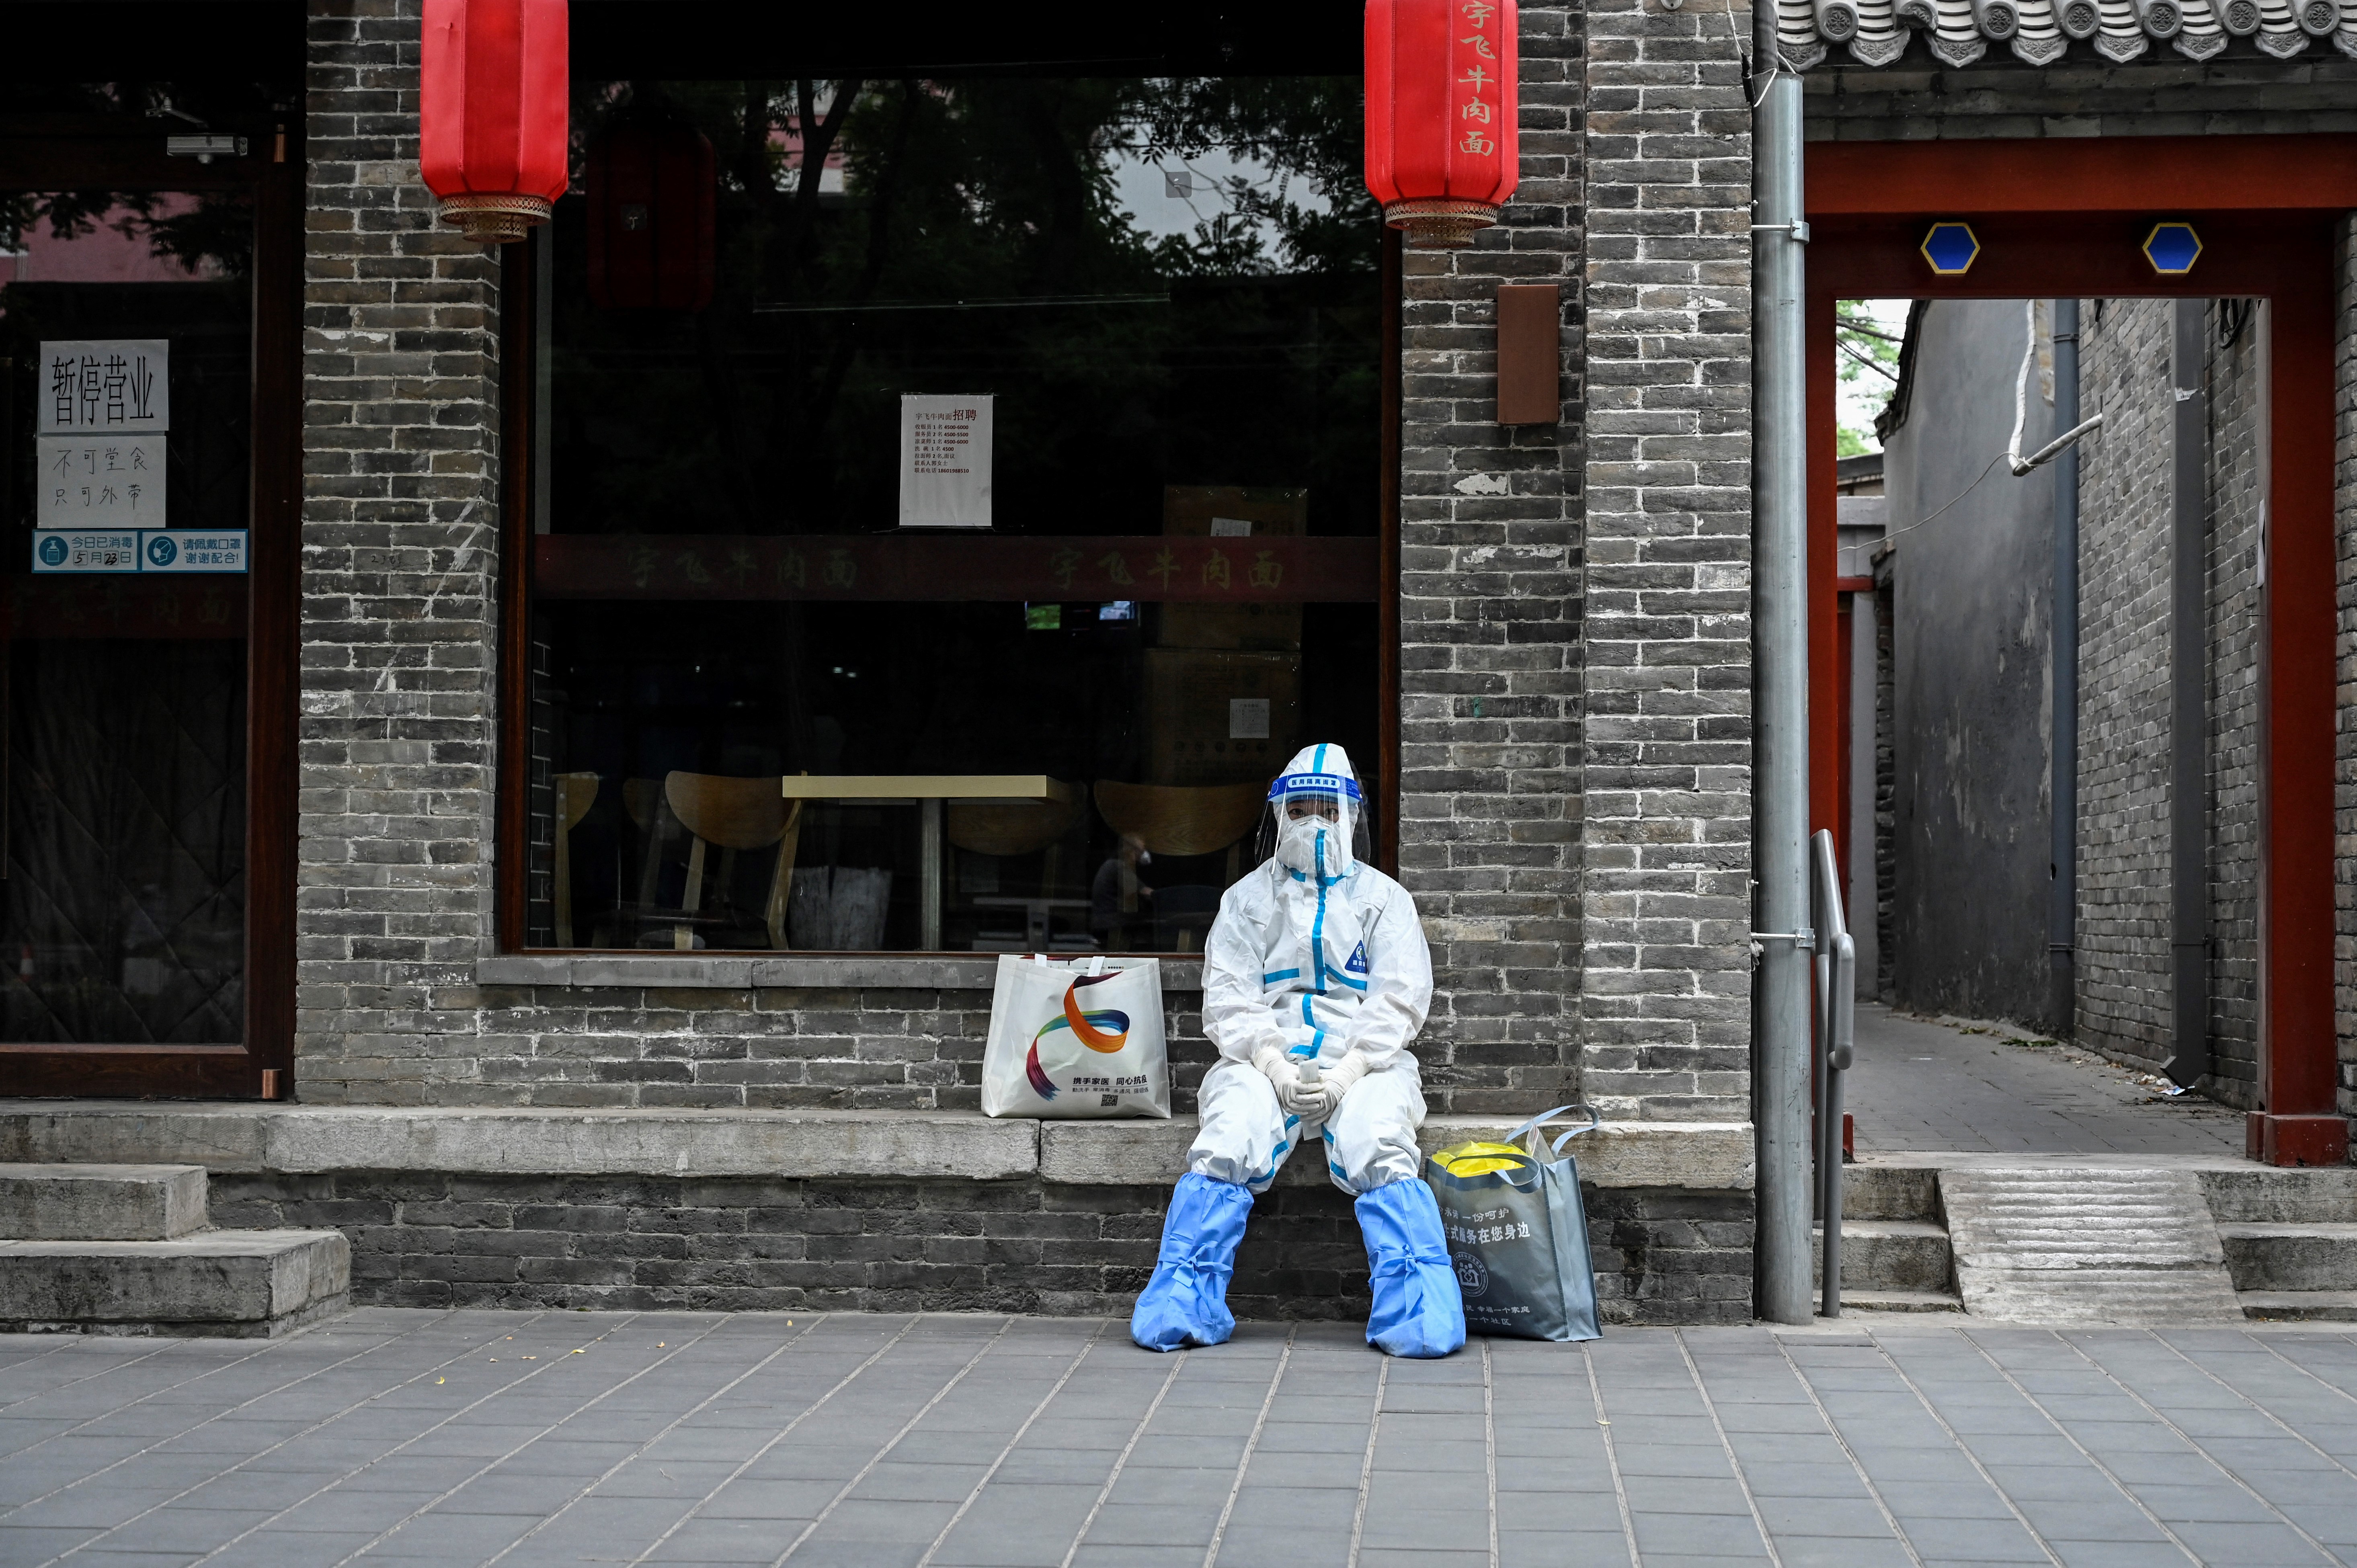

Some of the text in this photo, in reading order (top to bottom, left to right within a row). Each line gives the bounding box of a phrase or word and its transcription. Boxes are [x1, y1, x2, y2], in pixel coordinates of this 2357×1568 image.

[1458, 0, 1495, 156] 宇飞牛肉面
[52, 354, 154, 425] 暂停营业
[53, 447, 147, 478] 不可堂食
[55, 484, 141, 510] 只可外带
[72, 537, 133, 549] 今日已消毒
[183, 539, 241, 550] 请佩戴口罩
[185, 552, 238, 564] 谢谢配合!
[1048, 545, 1283, 592] 宇飞牛肉面
[1116, 1074, 1147, 1086] 同心抗疫
[1463, 1208, 1509, 1222] 一份呵护
[1465, 1317, 1511, 1326] 一个社区
